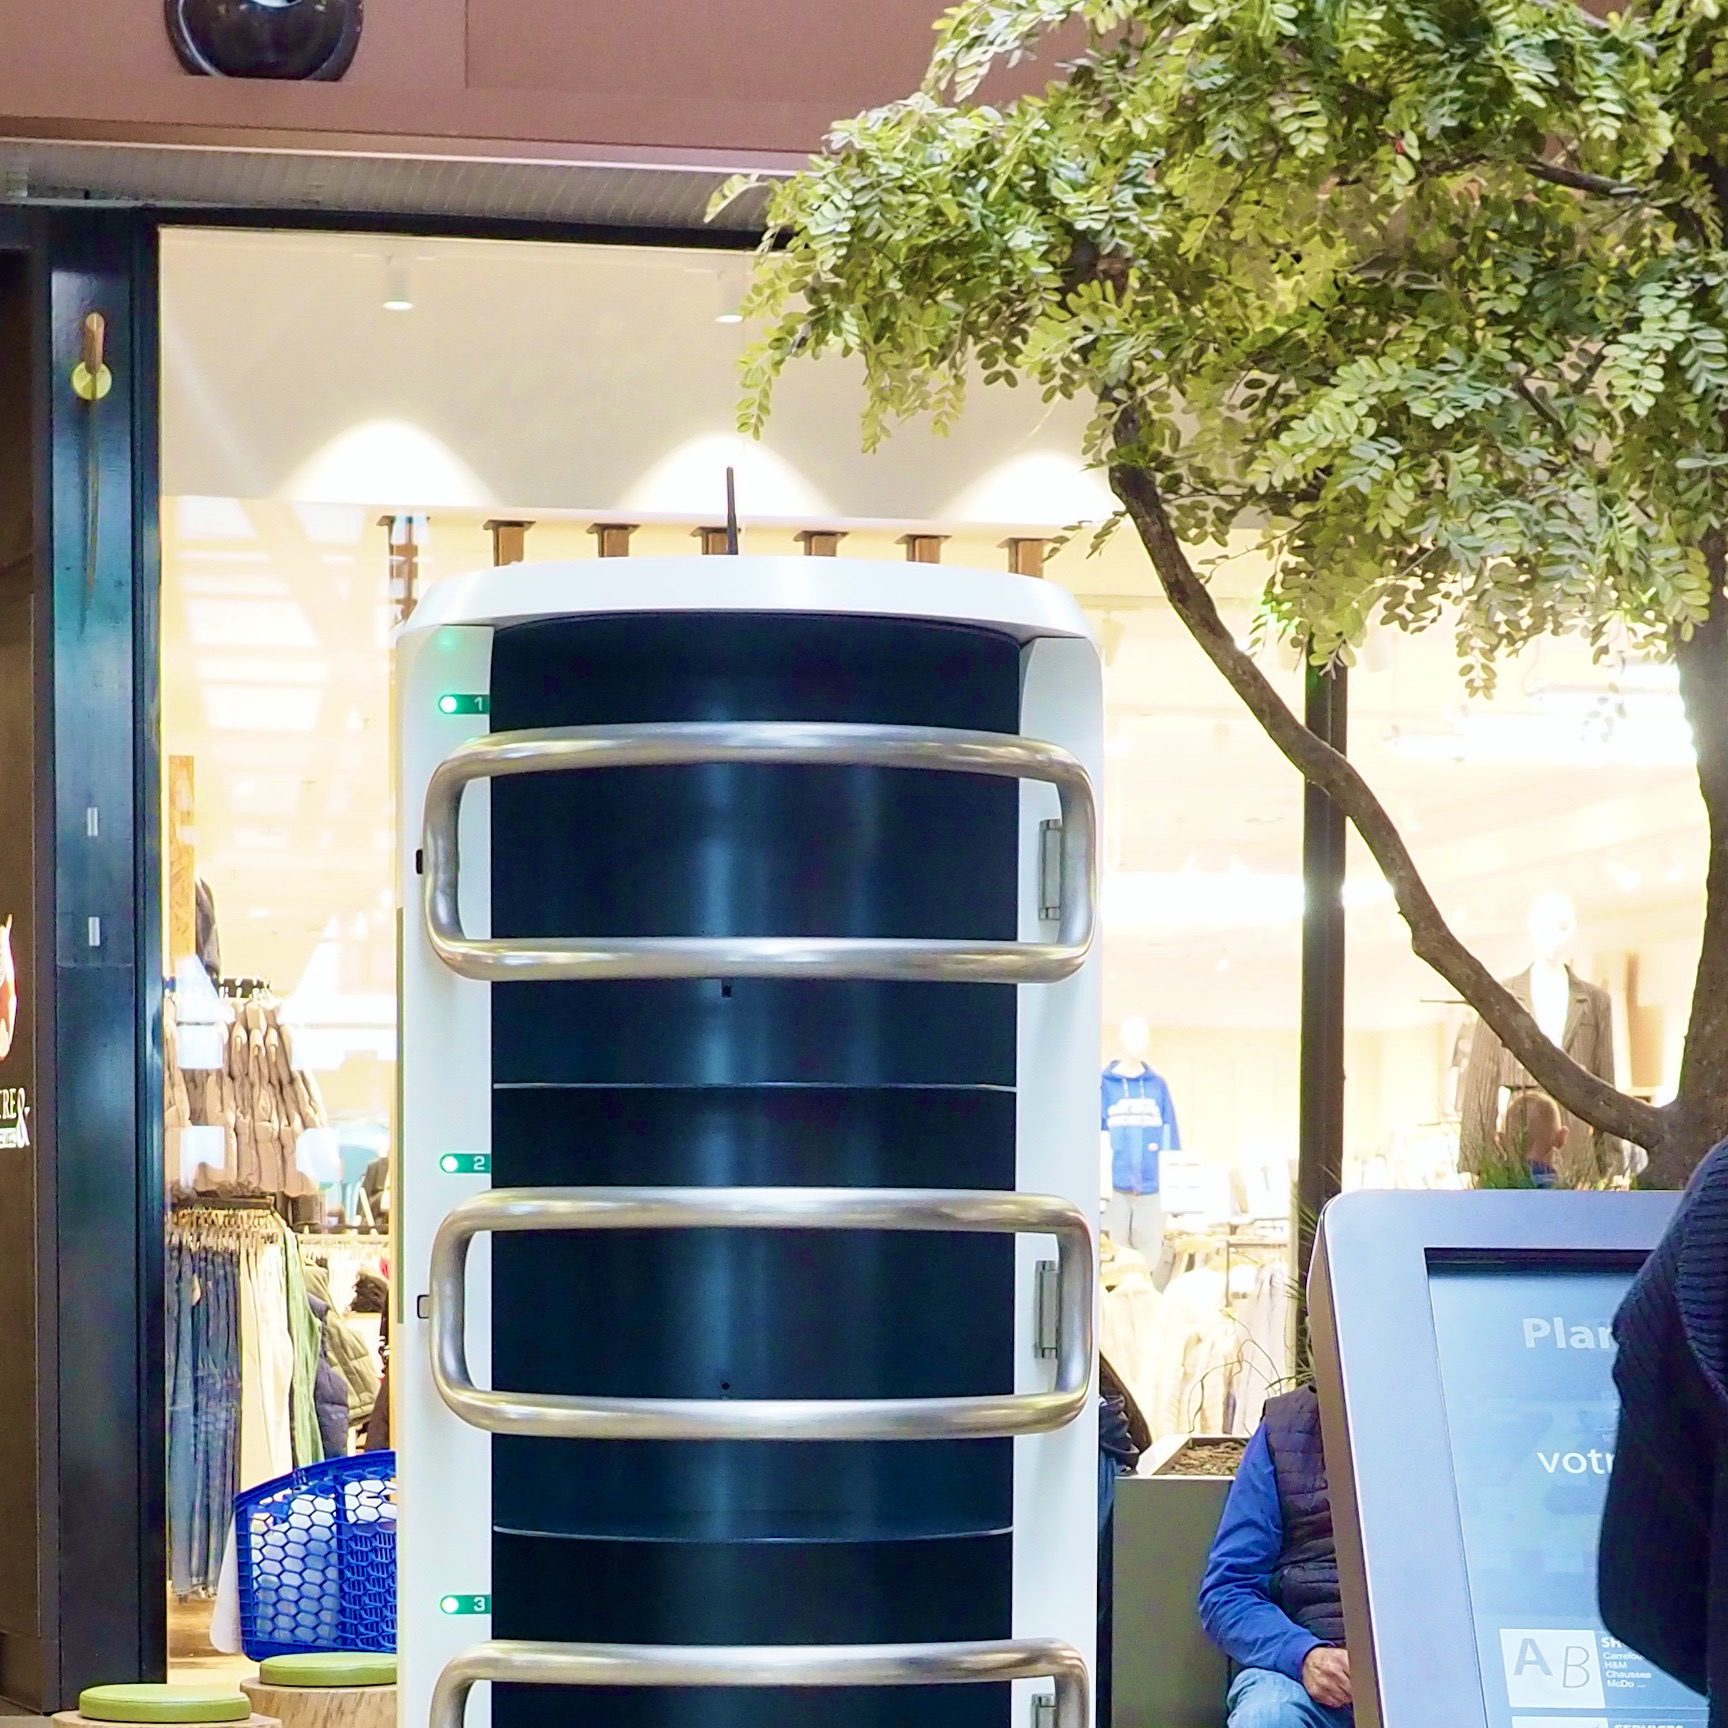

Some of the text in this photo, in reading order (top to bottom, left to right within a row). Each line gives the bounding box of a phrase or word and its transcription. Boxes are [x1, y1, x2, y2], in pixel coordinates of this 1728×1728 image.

[473, 696, 483, 712] 1
[473, 1155, 486, 1171] 2
[473, 1596, 486, 1612] 3
[1513, 1637, 1590, 1688] A B
